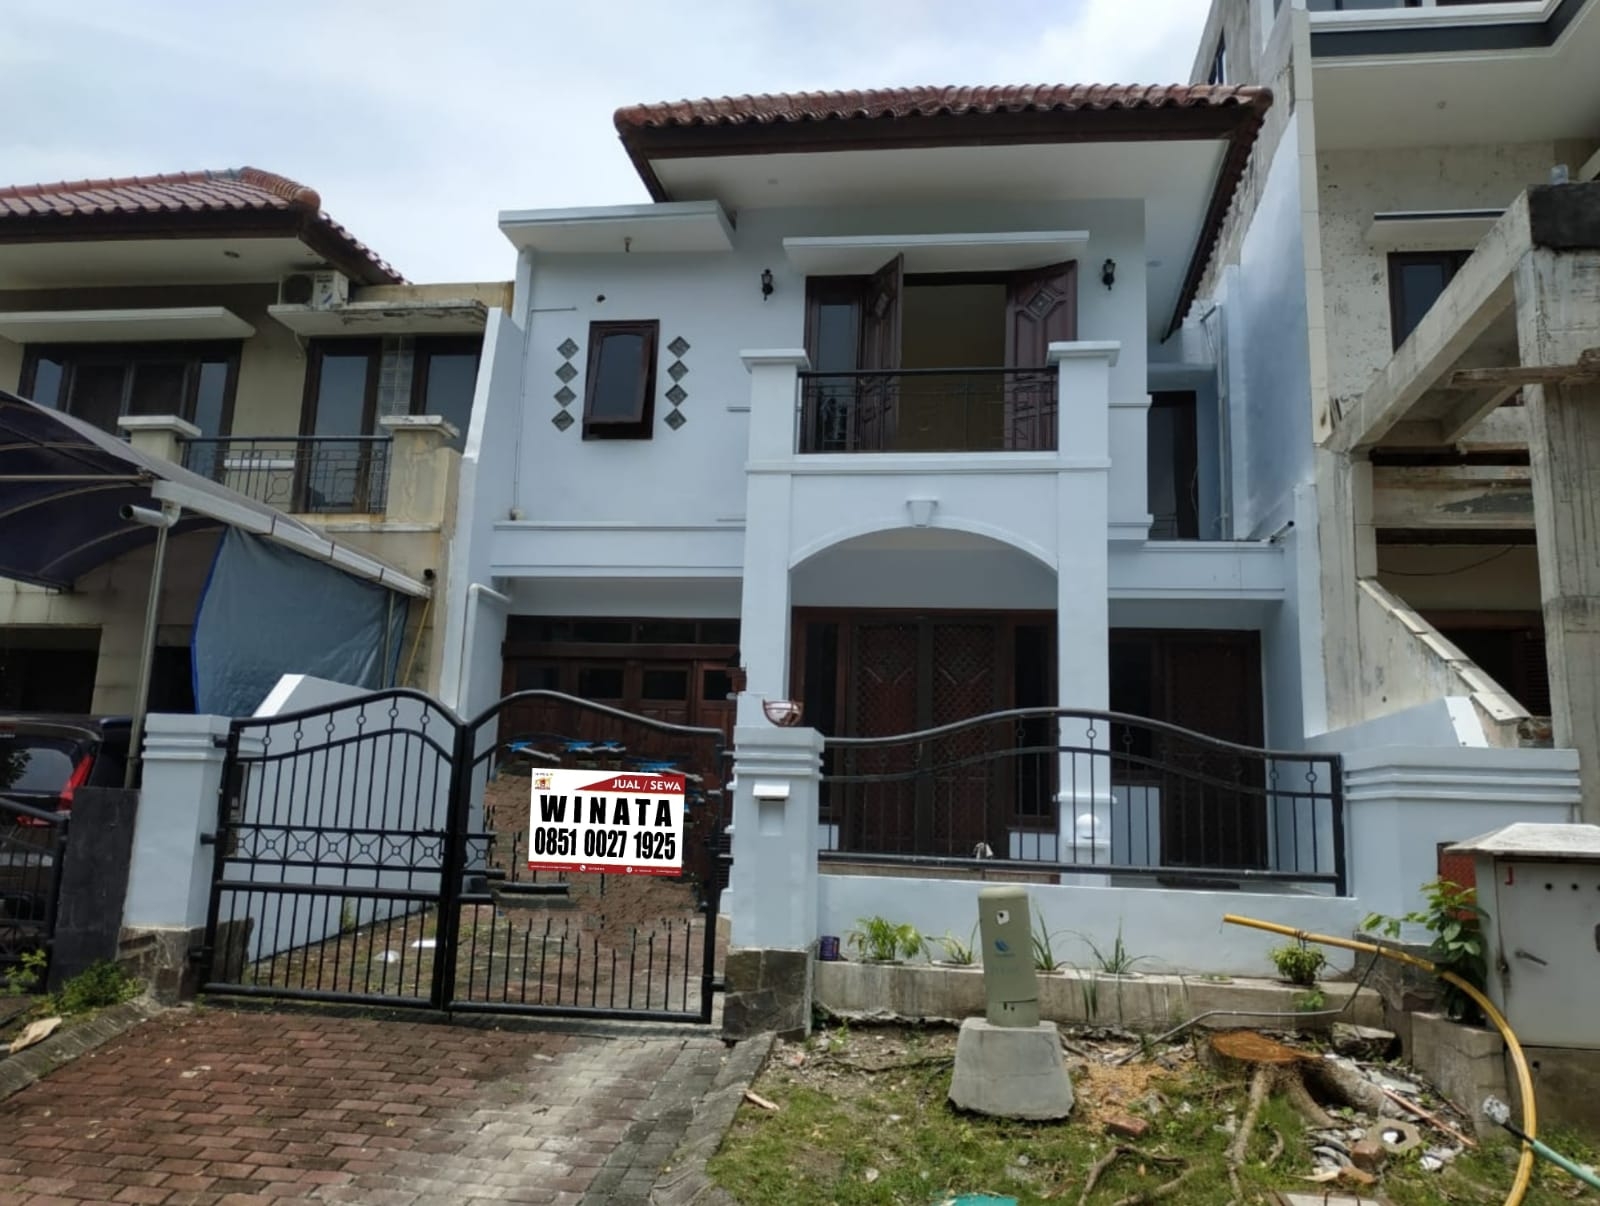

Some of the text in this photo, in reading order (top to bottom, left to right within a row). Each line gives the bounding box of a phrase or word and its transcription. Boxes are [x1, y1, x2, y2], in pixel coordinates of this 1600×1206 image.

[612, 779, 641, 790] JUAL
[650, 780, 681, 791] SEWA
[540, 795, 672, 827] WINATA
[534, 827, 676, 860] 0851 0027 1925
